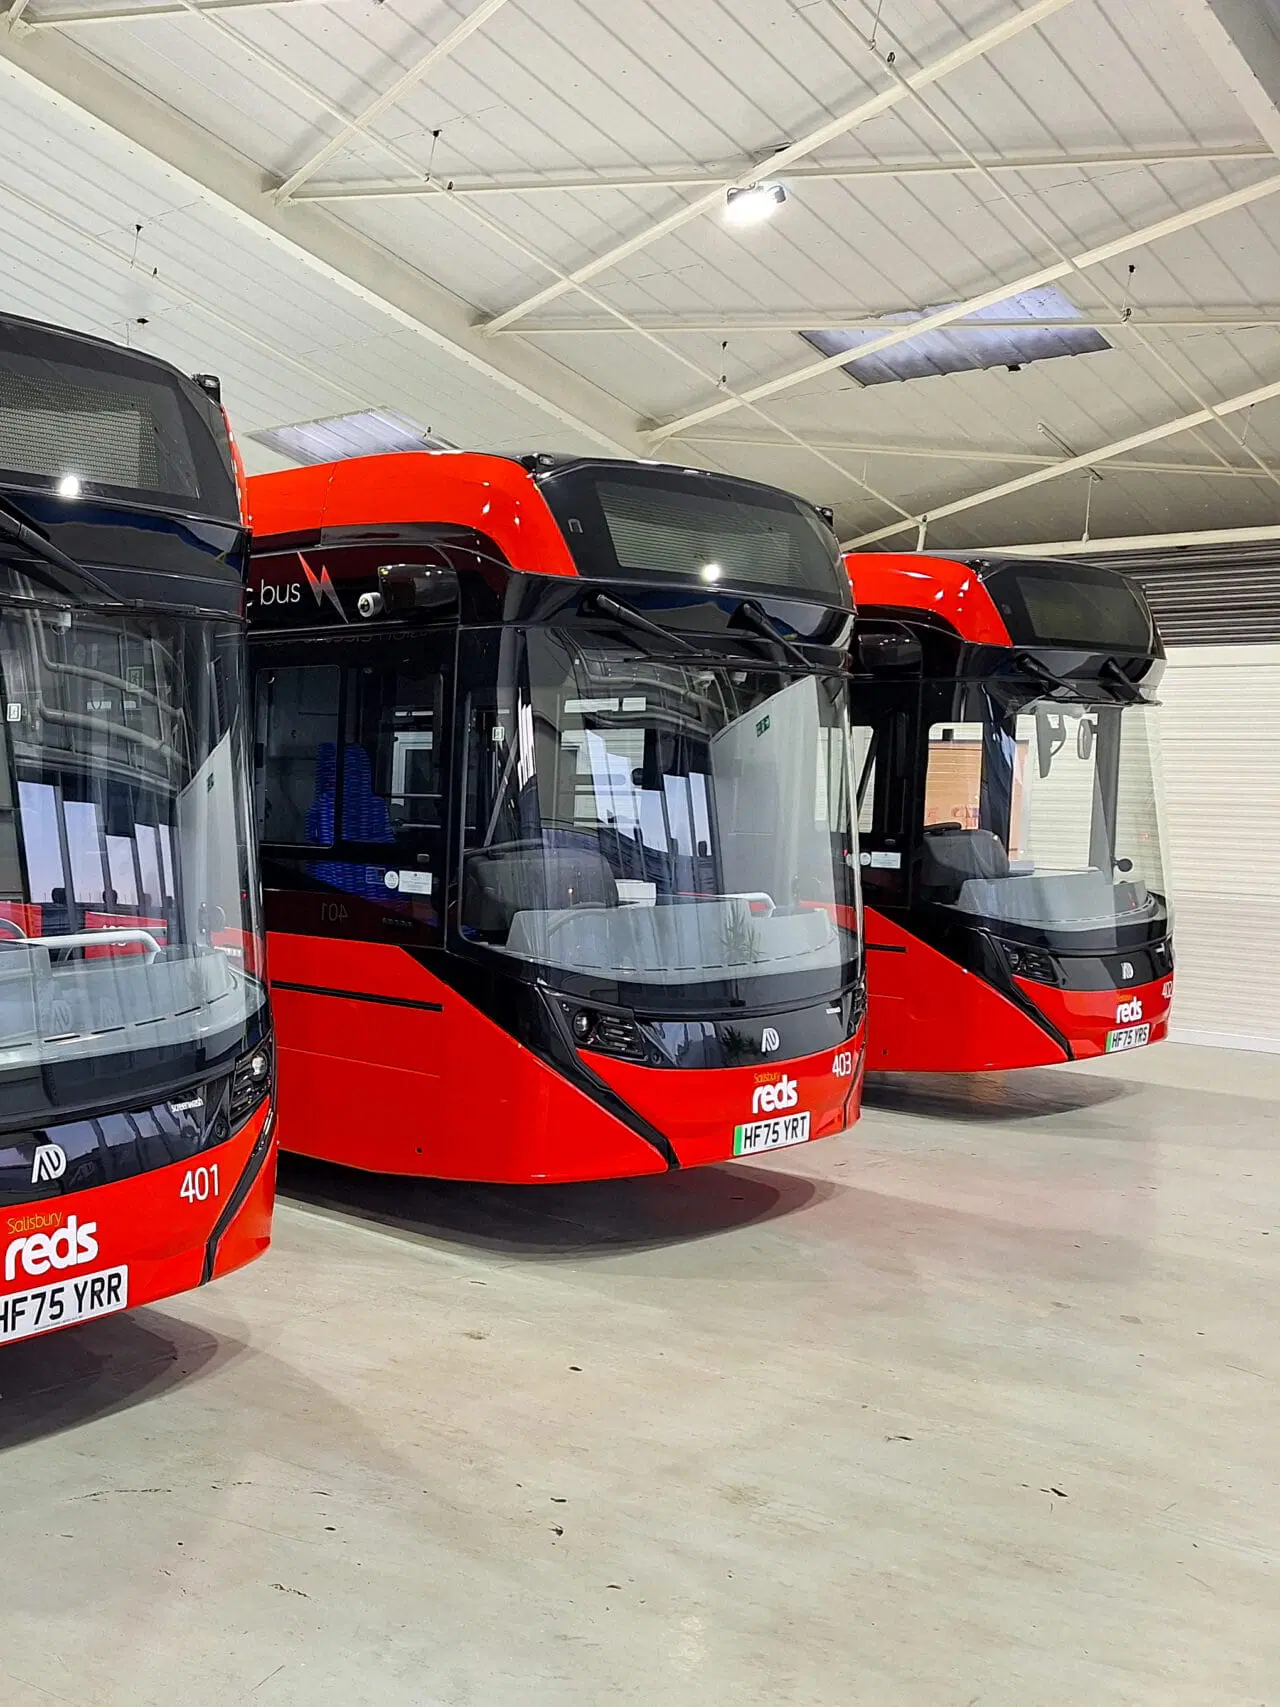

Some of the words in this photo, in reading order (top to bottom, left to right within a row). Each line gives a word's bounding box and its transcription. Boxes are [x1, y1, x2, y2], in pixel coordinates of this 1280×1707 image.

[260, 578, 301, 606] bus
[1115, 996, 1143, 1024] reds
[1111, 1029, 1134, 1049] HF75
[832, 1051, 852, 1078] 403
[752, 1074, 799, 1114] reds
[743, 1121, 780, 1150] HF75
[783, 1115, 808, 1141] YRT
[179, 1163, 219, 1204] 401
[7, 1211, 63, 1235] Salisbury
[4, 1215, 99, 1281] reds
[73, 1272, 122, 1314] YRR
